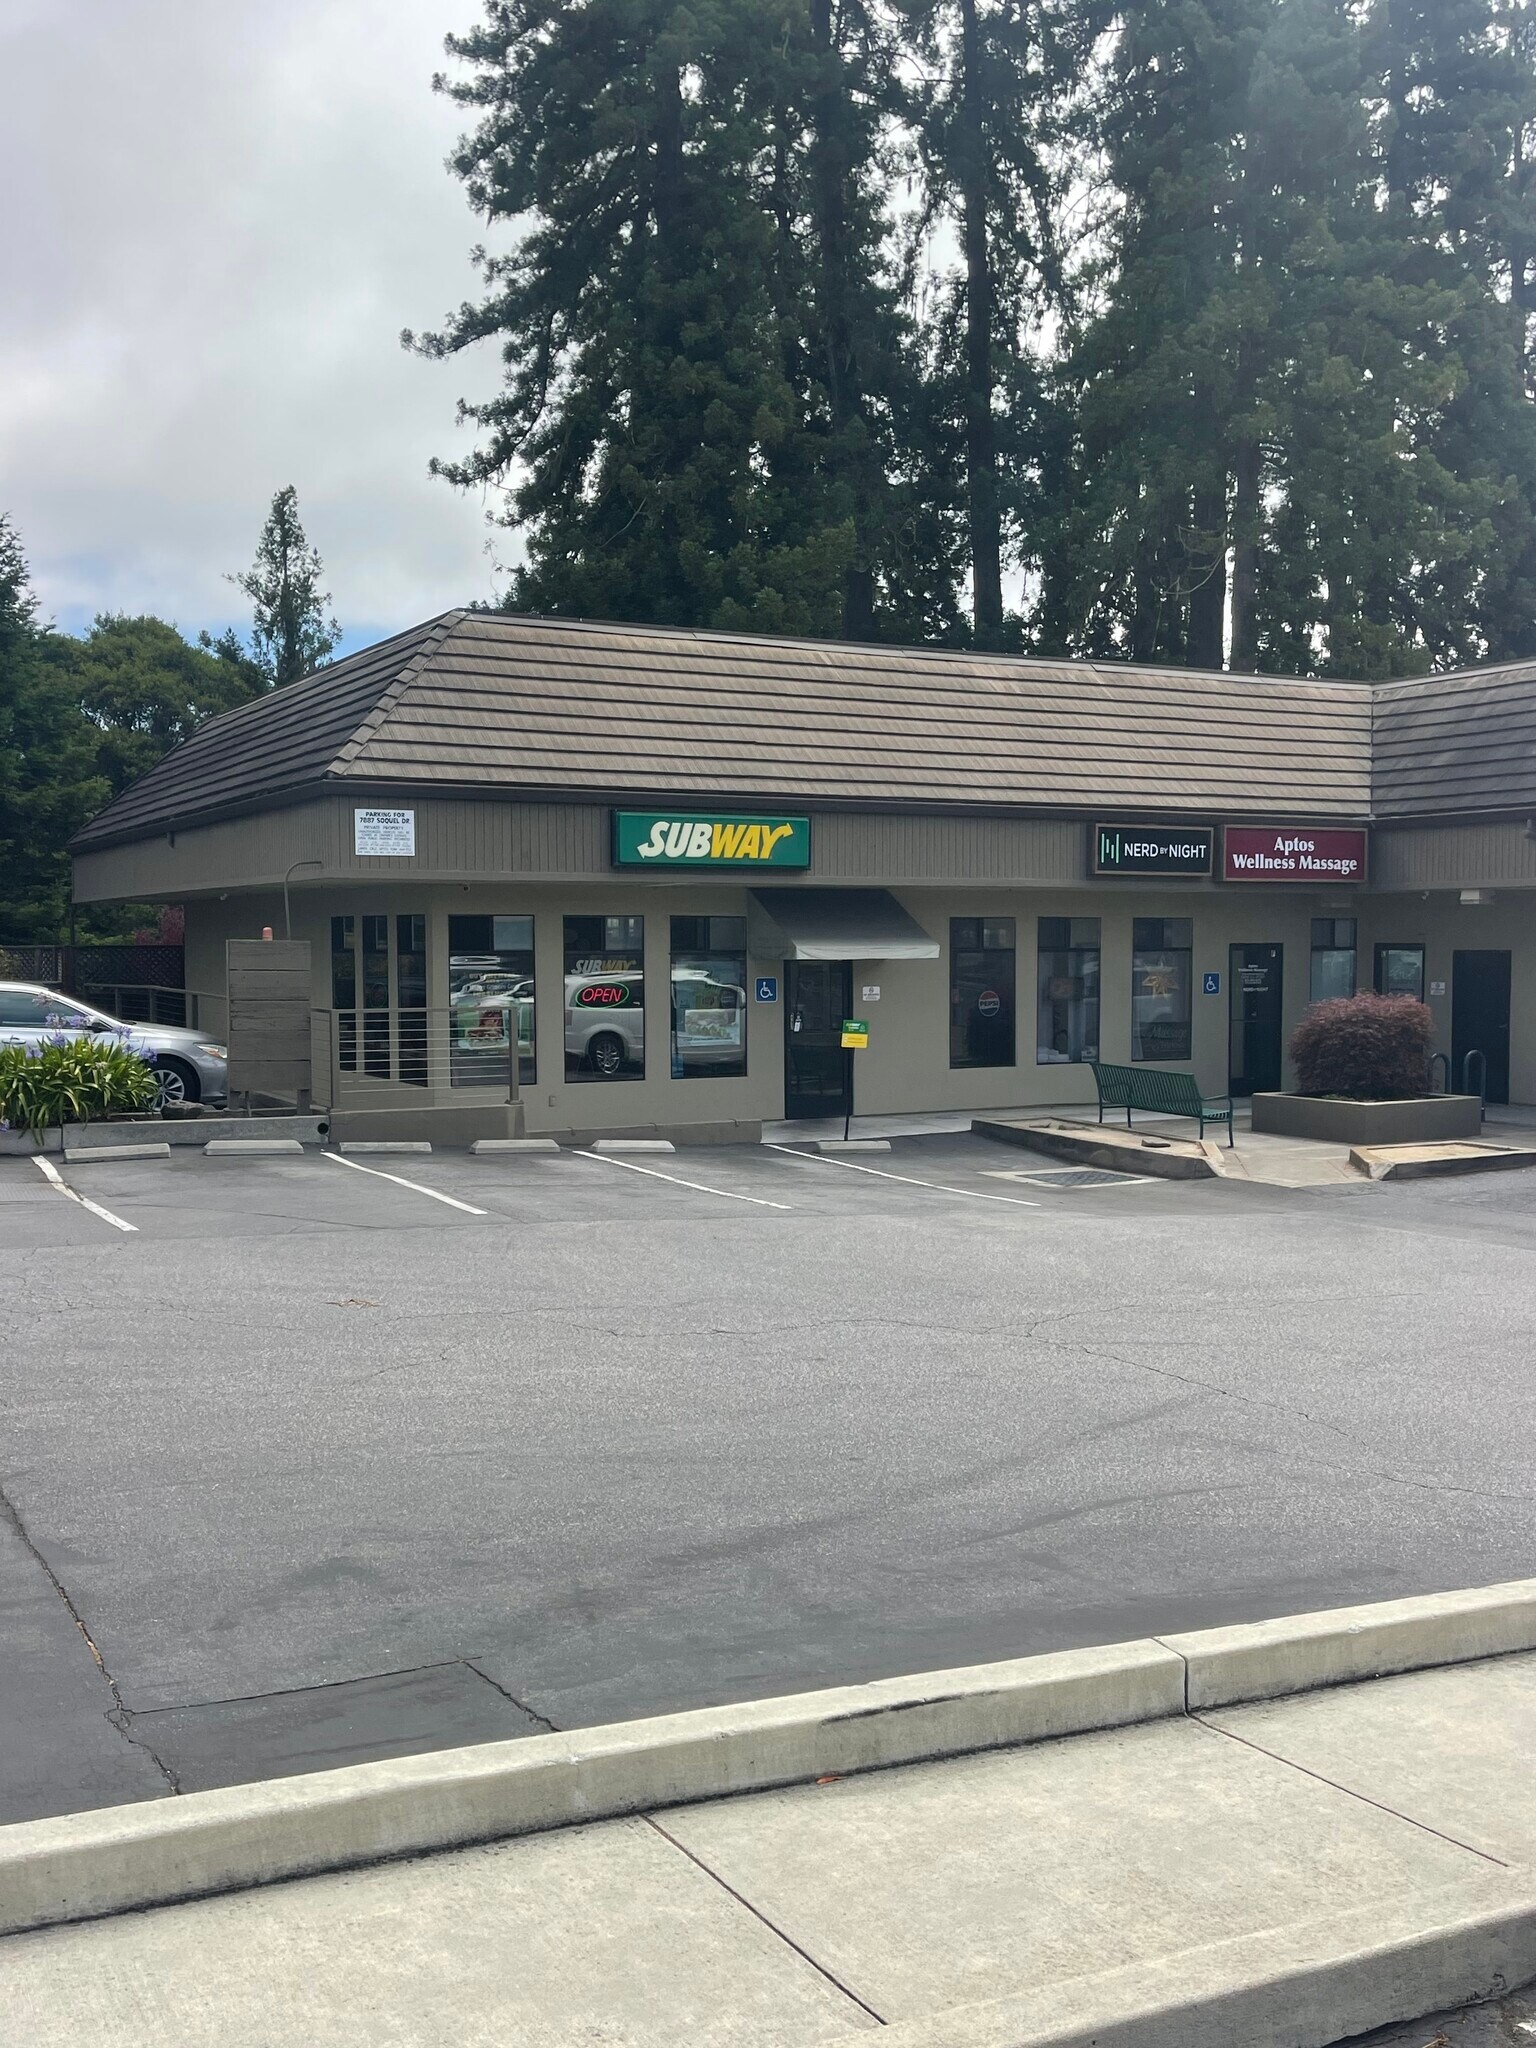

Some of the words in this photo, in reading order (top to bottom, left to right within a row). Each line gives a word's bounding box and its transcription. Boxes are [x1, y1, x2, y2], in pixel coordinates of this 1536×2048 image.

[637, 821, 794, 860] SUBWAY
[1273, 836, 1315, 855] Aptos
[1124, 842, 1158, 858] NERD
[1160, 847, 1168, 855] BY
[1168, 844, 1207, 859] NIGHT
[1232, 853, 1296, 870] Wellness
[1298, 856, 1358, 874] Massage
[570, 959, 637, 975] SUBWAY
[582, 988, 623, 1002] OPEN
